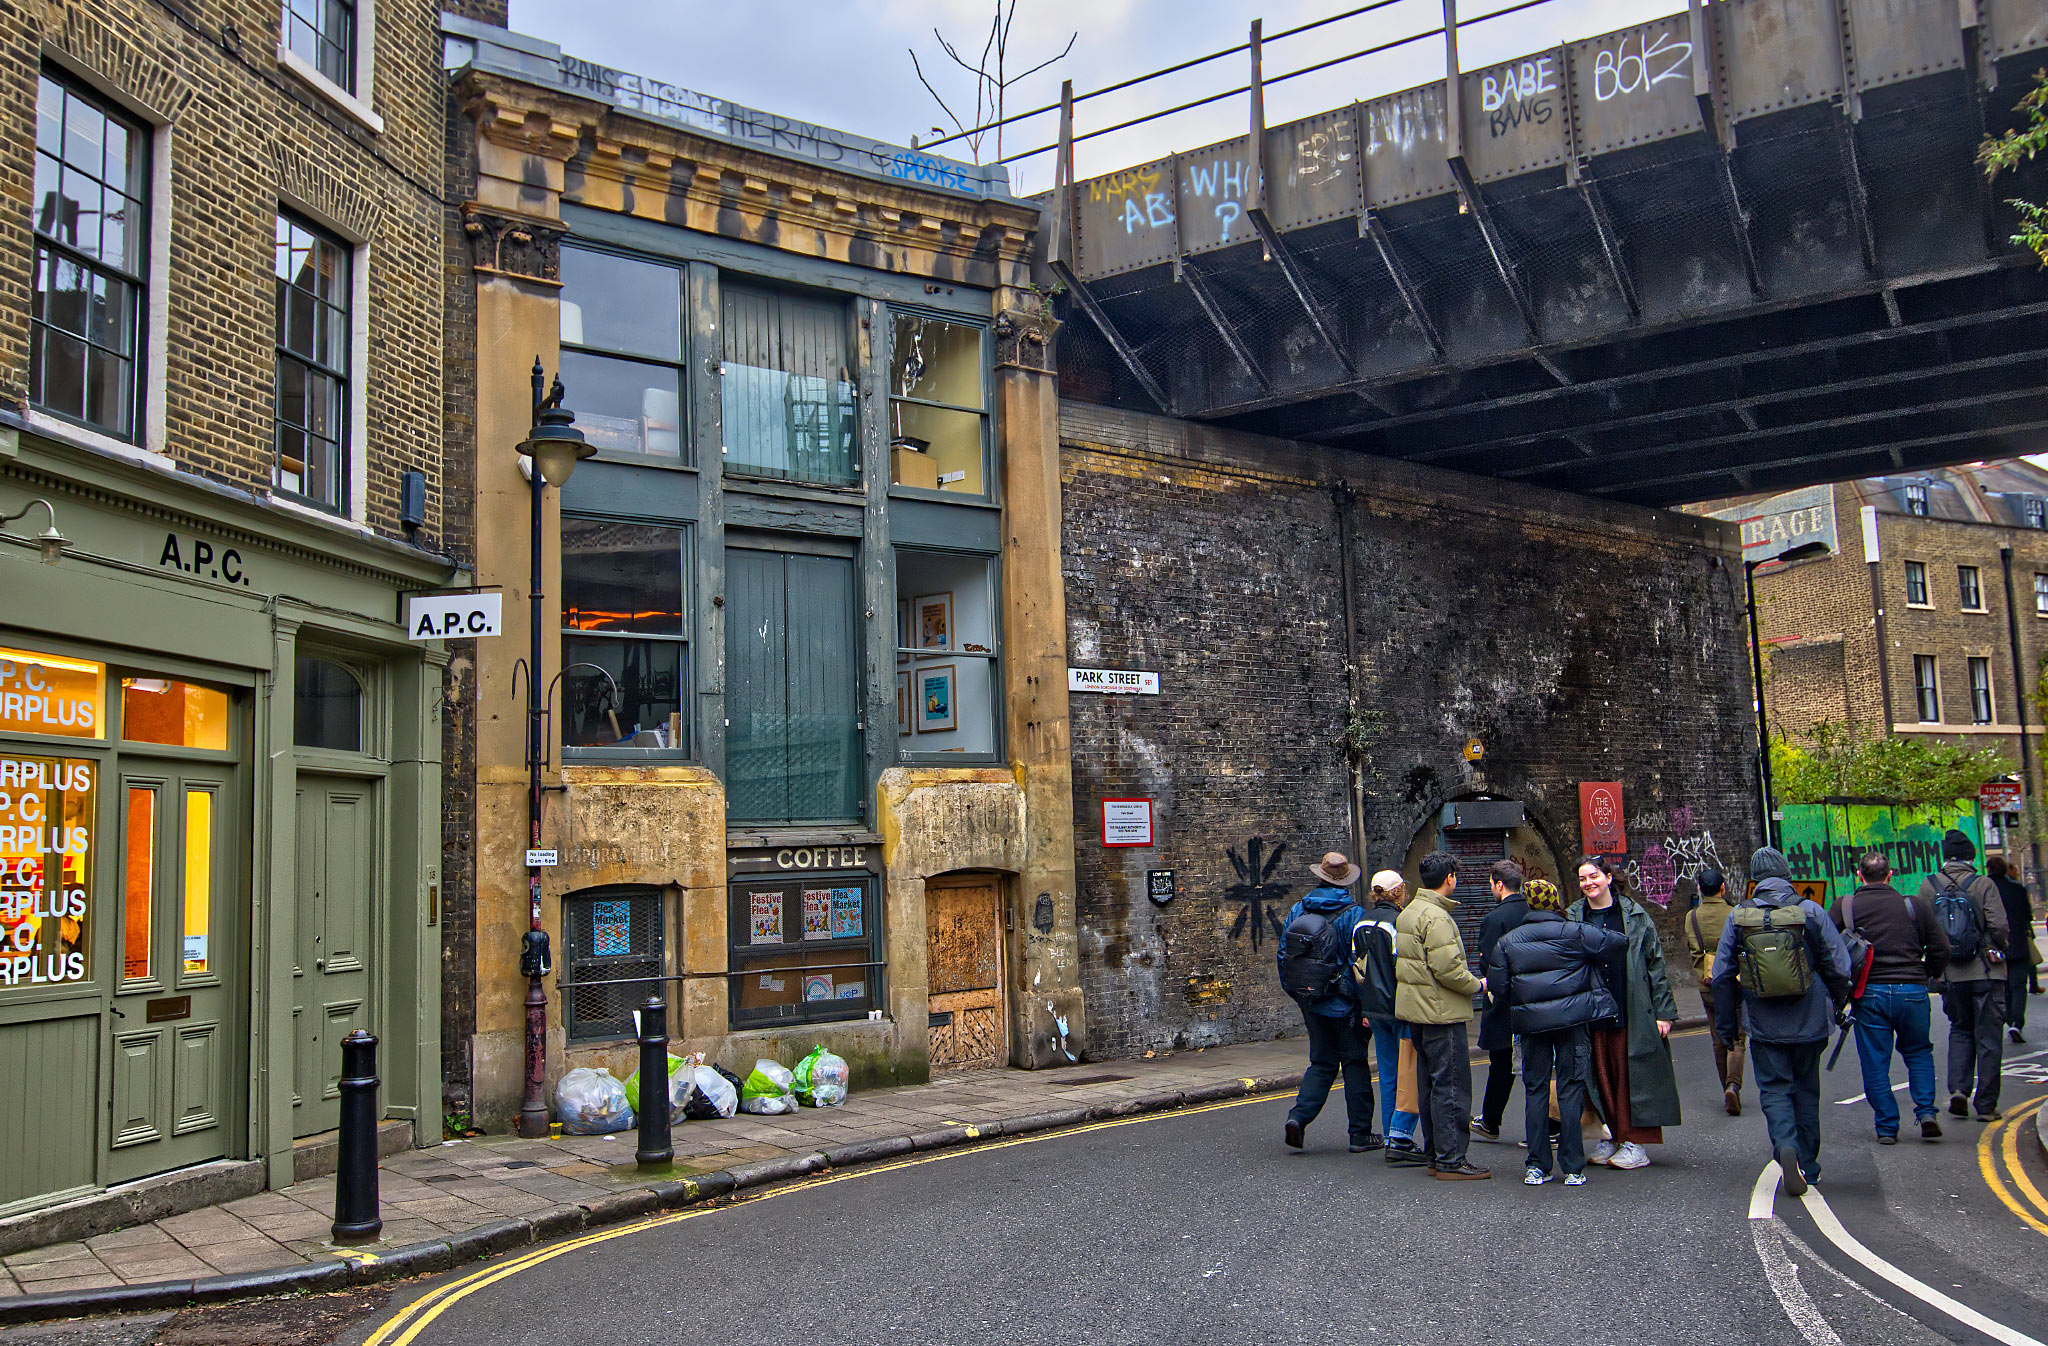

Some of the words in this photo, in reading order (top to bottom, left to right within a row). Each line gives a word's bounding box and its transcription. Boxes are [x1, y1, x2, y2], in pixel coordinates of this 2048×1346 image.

[1482, 57, 1557, 112] BABE
[159, 532, 250, 586] A.P.C.
[416, 610, 493, 636] A.P.C.
[1076, 671, 1104, 684] PARK
[1108, 672, 1141, 685] STREET
[1595, 797, 1609, 807] THE
[1594, 806, 1613, 817] ARCH
[1598, 816, 1609, 826] CO
[776, 846, 867, 869] COFFEE
[751, 893, 782, 905] Festive
[832, 889, 848, 900] Flea
[595, 903, 614, 914] Flea
[832, 899, 860, 910] Market
[751, 905, 770, 916] Flea
